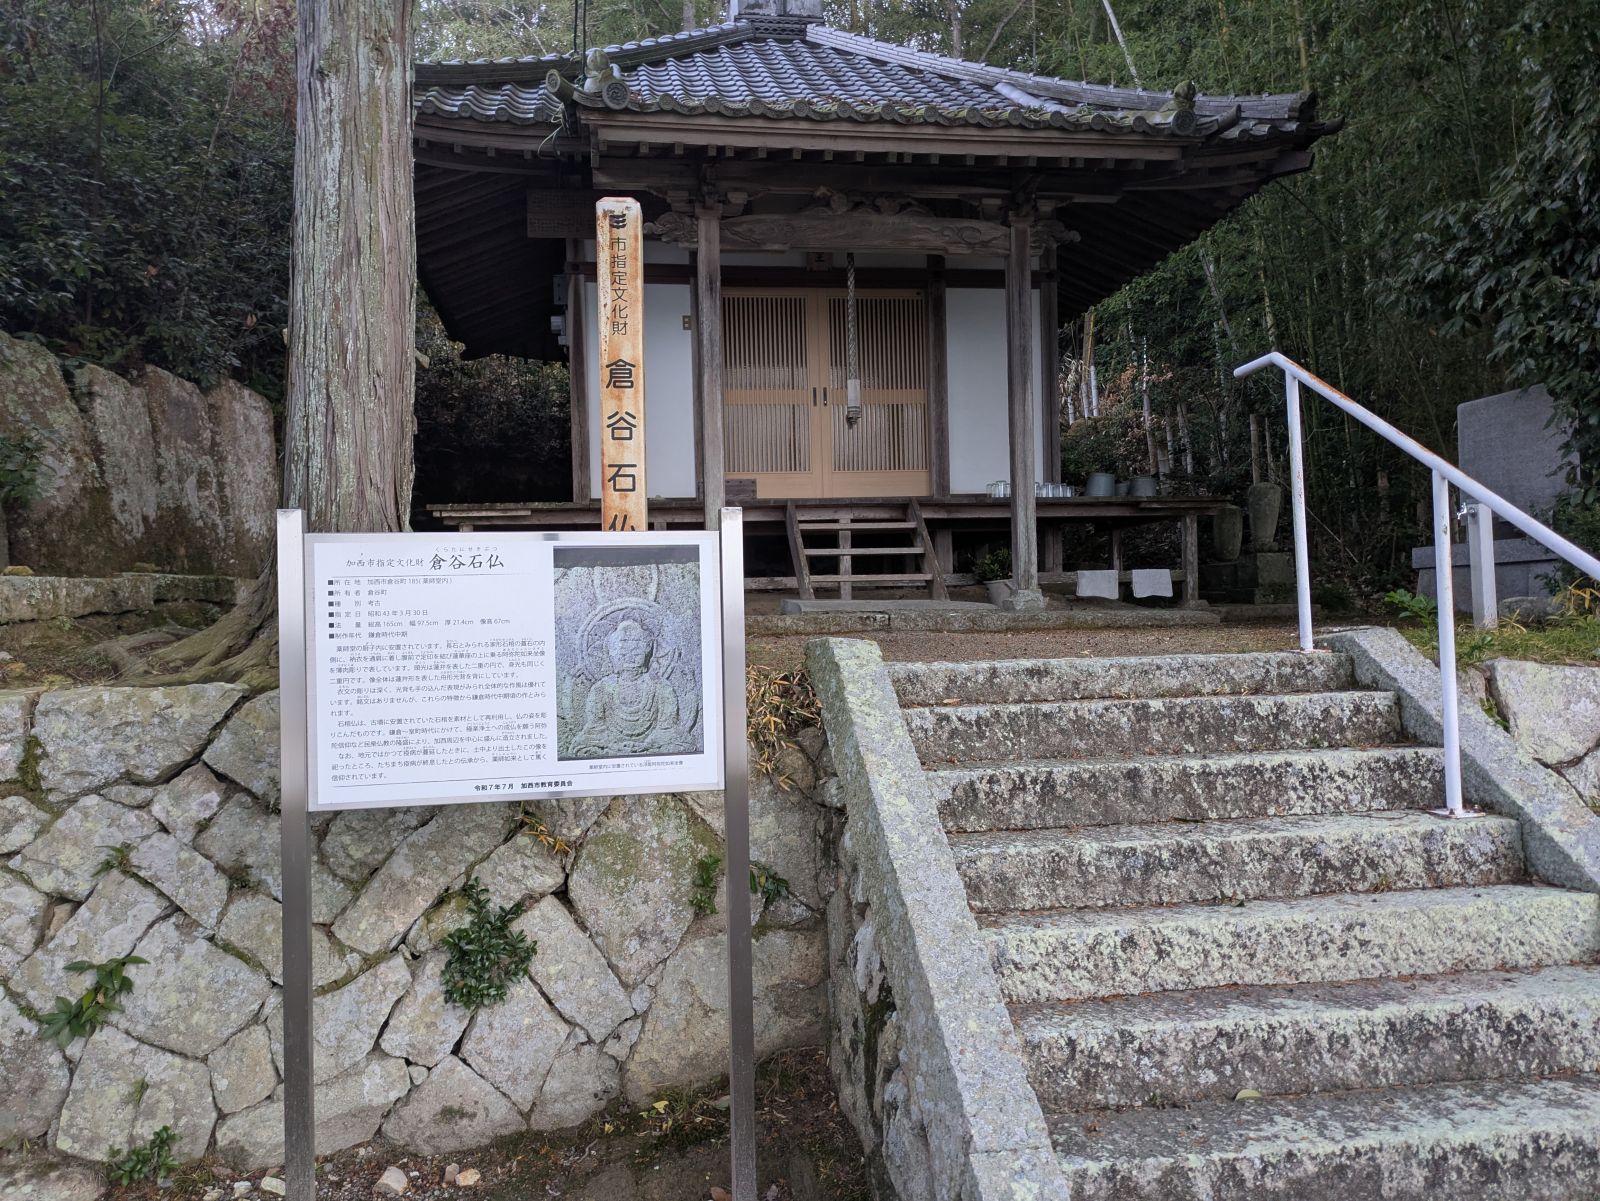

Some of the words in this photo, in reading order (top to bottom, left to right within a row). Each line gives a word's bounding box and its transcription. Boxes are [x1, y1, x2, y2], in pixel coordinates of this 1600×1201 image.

[609, 237, 628, 336] 市指定文化財
[345, 558, 424, 568] 加西市指定文化財
[429, 553, 504, 571] 倉谷石仏
[331, 709, 353, 717] れます。
[331, 772, 386, 782] 信仰されています。
[521, 780, 573, 789] 加西市教育委員会
